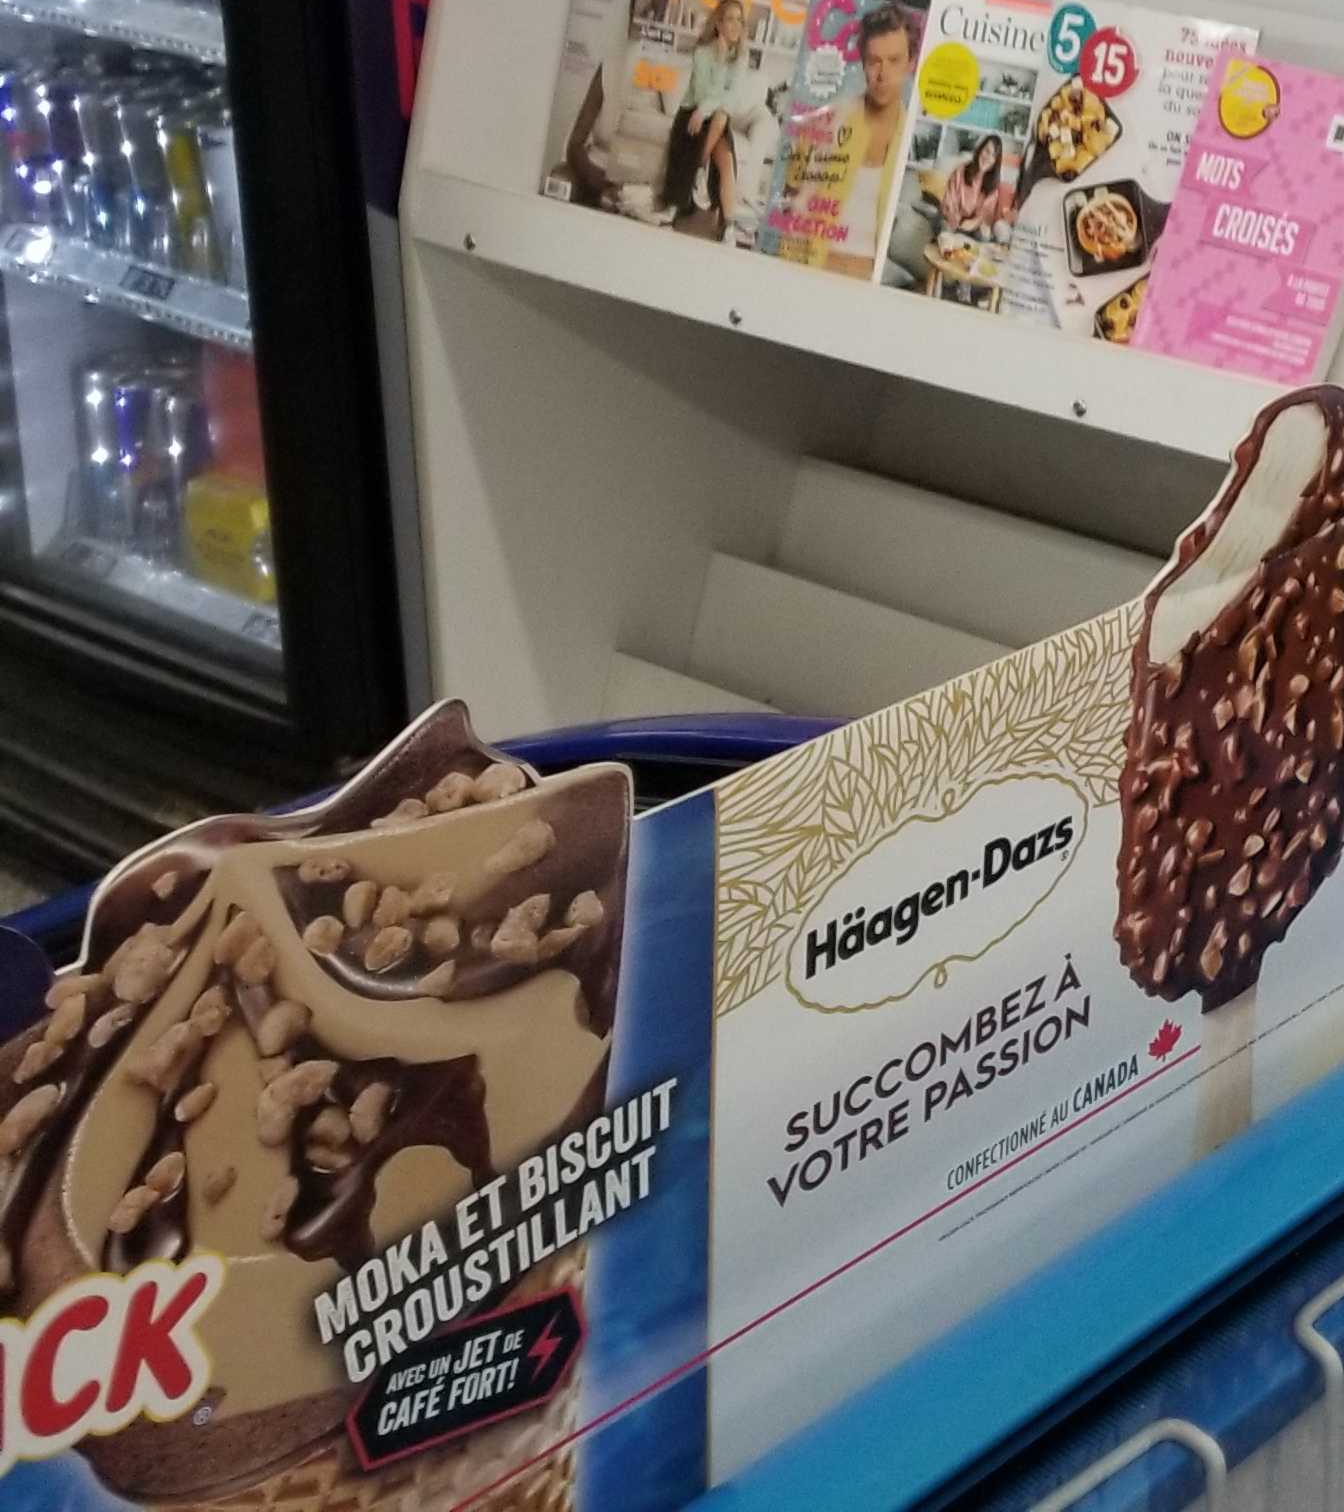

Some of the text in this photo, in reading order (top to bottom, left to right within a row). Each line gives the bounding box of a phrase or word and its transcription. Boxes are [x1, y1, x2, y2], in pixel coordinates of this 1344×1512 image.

[939, 4, 1045, 52] Cuisine
[1054, 12, 1084, 63] 5
[1091, 41, 1128, 86] 15
[808, 197, 841, 216] ONE
[1196, 151, 1245, 190] MOTS
[1211, 201, 1300, 256] CROISÉS
[805, 815, 1075, 979] Häagen-Dazs
[785, 986, 1047, 1152] SUCCOMBEZ
[1053, 952, 1083, 995] À
[767, 1104, 910, 1208] VOTRE
[923, 995, 1091, 1121] PASSION
[946, 1054, 1139, 1191] CONFECTIONNÉ AU CANADA
[314, 1077, 678, 1343] MOKA ET BISCUIT
[343, 1146, 658, 1383] CROUSTILLANT
[0, 1272, 208, 1453] CK
[377, 1356, 518, 1437] CAFÉ FORT!
[386, 1329, 525, 1394] AVEC UN JET DE
